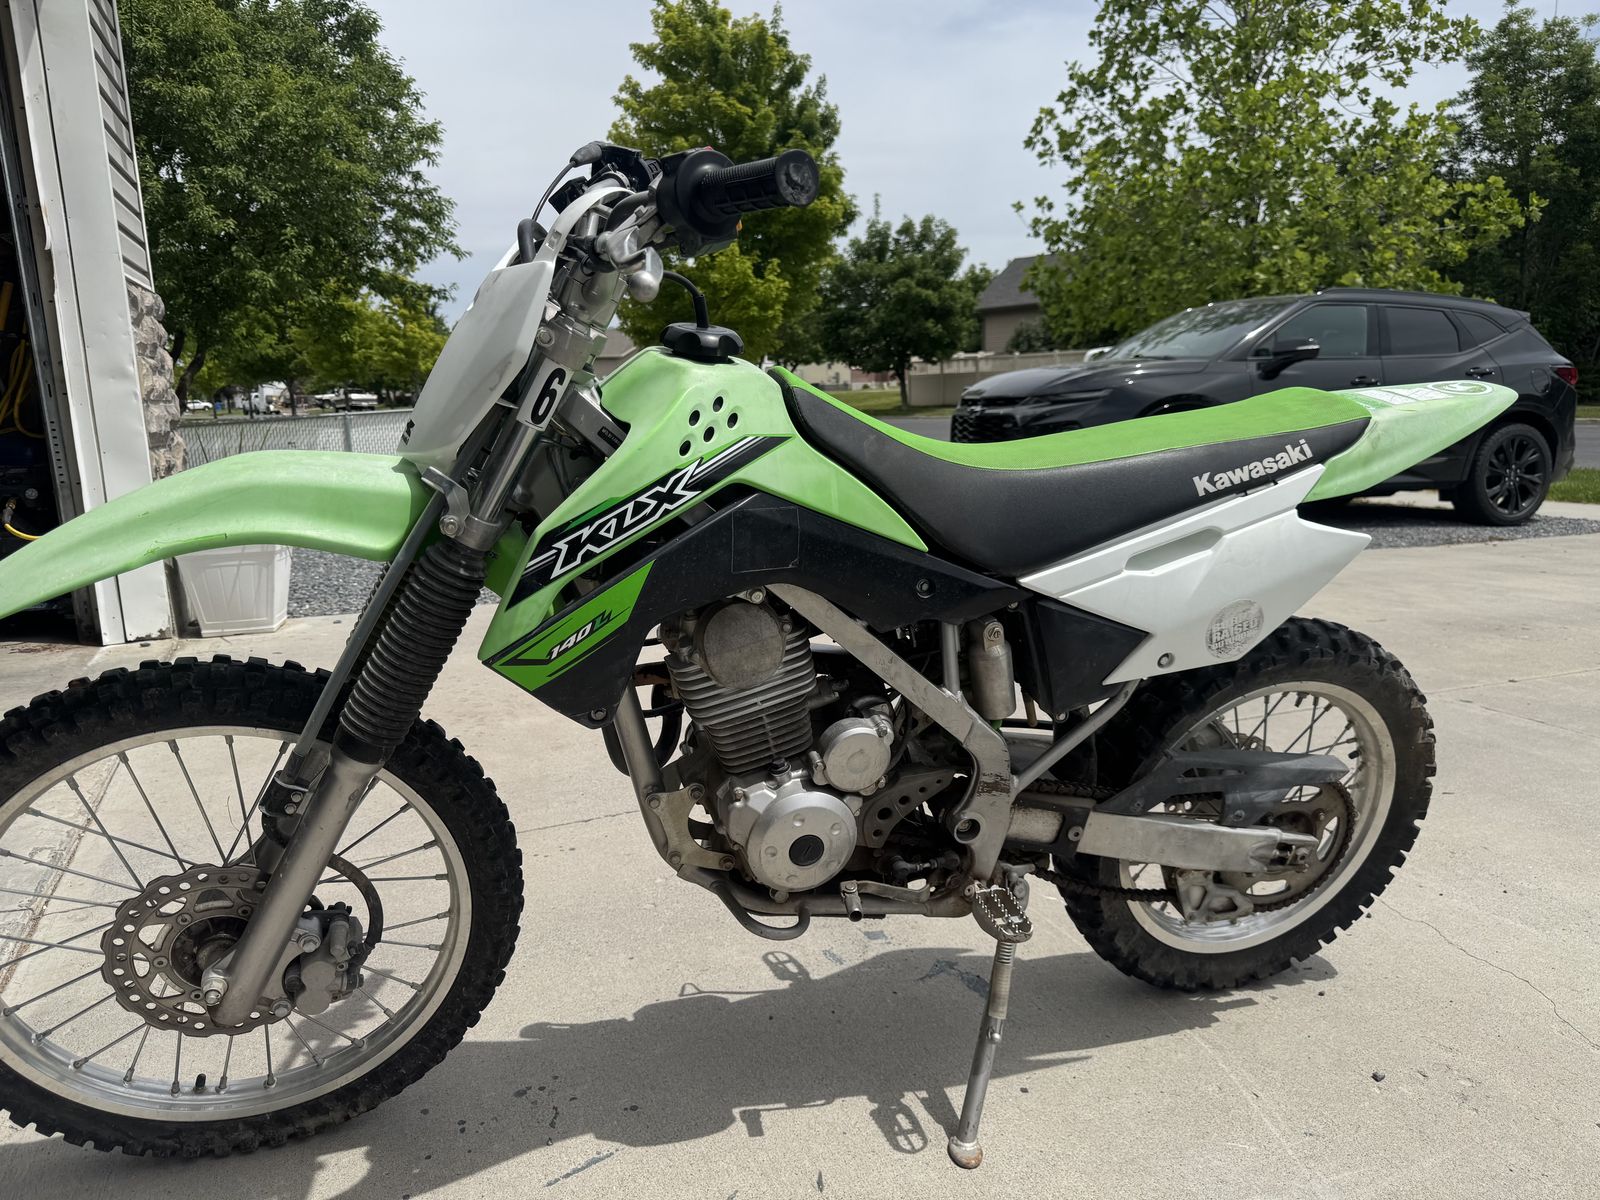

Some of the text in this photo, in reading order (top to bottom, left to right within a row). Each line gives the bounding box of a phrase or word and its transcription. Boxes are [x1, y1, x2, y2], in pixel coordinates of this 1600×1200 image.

[530, 367, 567, 425] 6
[1192, 438, 1314, 497] Kawasaki
[550, 456, 703, 580] KLX
